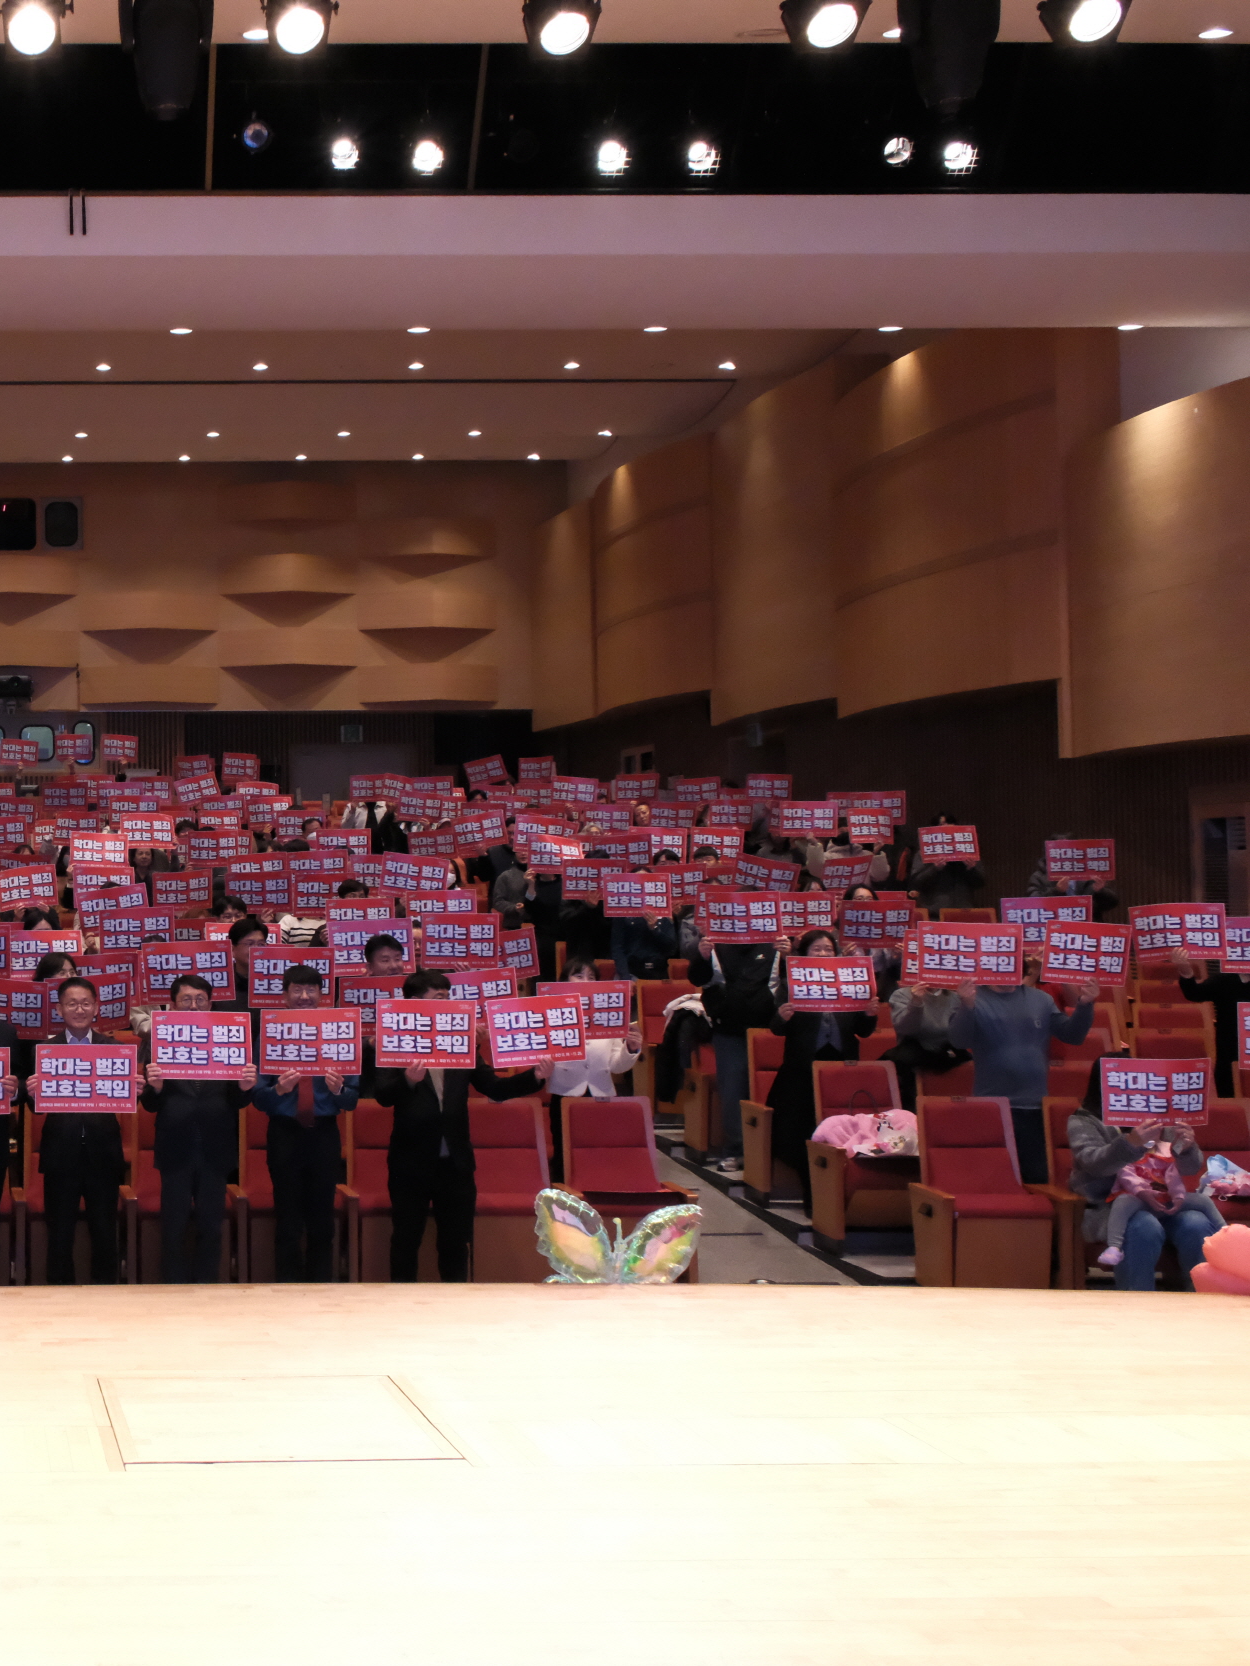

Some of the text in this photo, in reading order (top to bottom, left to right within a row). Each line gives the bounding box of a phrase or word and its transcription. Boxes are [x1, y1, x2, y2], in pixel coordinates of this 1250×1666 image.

[783, 809, 833, 817] 학대는 범죄
[783, 820, 833, 828] 보호는 책임
[74, 839, 124, 850] 학대는 범죄
[922, 833, 972, 843] 학대는 범죄
[74, 851, 124, 862] 보호는 책임
[924, 844, 974, 854] 보호는 책임
[1049, 848, 1108, 859] 학대는 범죄
[1050, 861, 1109, 871] 보호는 책임
[0, 873, 52, 888] 학대는 범죄
[607, 882, 666, 893] 학대는 범죄
[1, 886, 53, 903] 보호는 책임
[608, 896, 666, 907] 보호는 책임
[709, 902, 775, 916] 학대는 범죄
[710, 918, 777, 932] 보호는 책임
[1135, 914, 1218, 930] 학대는 범죄
[426, 924, 493, 938] 학대는 범죄
[426, 942, 493, 956] 보호는 책임
[923, 934, 1015, 951] 학대는 범죄
[1050, 933, 1124, 952] 학대는 범죄
[1138, 932, 1219, 950] 보호는 책임
[923, 954, 1014, 971] 보호는 책임
[1047, 953, 1123, 972] 보호는 책임
[791, 968, 868, 981] 학대는 범죄
[794, 985, 869, 999] 보호는 책임
[382, 1013, 468, 1030] 학대는 범죄
[493, 1008, 577, 1029] 학대는 범죄
[157, 1025, 244, 1042] 학대는 범죄
[266, 1022, 353, 1039] 학대는 범죄
[382, 1035, 468, 1052] 보호는 책임
[497, 1029, 579, 1051] 보호는 책임
[157, 1046, 245, 1064] 보호는 책임
[266, 1044, 354, 1061] 보호는 책임
[41, 1058, 129, 1075] 학대는 범죄
[41, 1080, 129, 1097] 보호는 책임
[1107, 1072, 1203, 1090] 학대는 범죄
[1108, 1094, 1202, 1112] 보호는 책임
